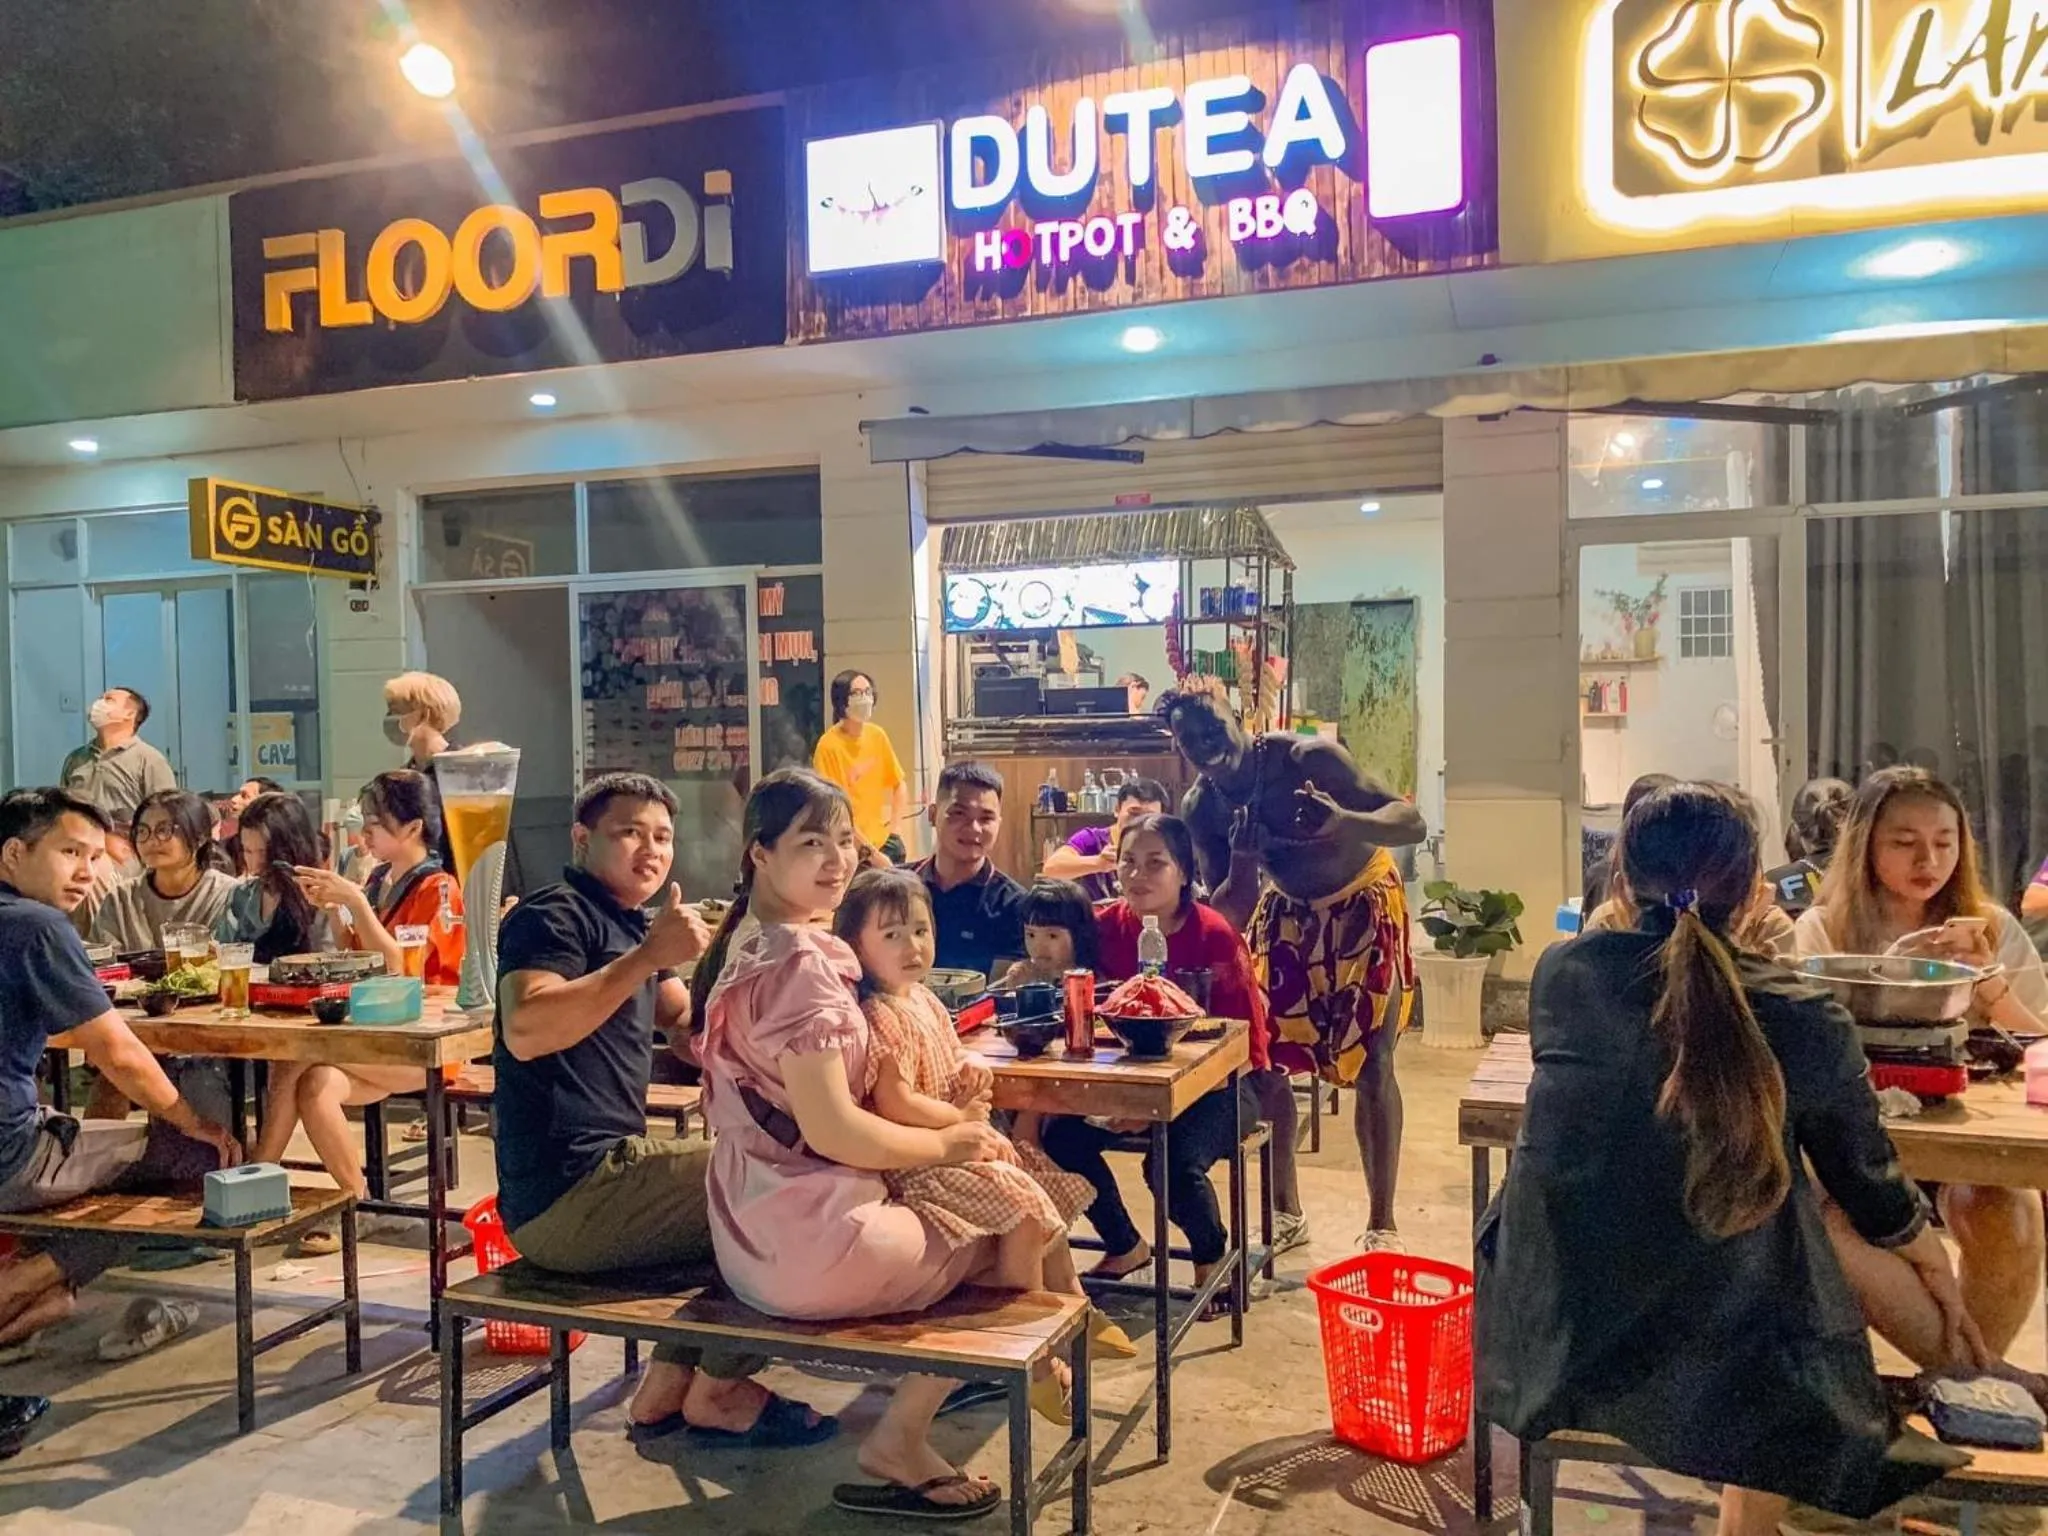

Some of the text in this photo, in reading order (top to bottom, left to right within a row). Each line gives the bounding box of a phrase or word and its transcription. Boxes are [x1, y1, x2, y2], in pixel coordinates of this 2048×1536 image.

[1886, 0, 2048, 113] LA
[950, 62, 1347, 211] DUTEA
[975, 187, 1319, 272] HOTPOT & BBQ
[267, 511, 370, 557] SÀN GỖ
